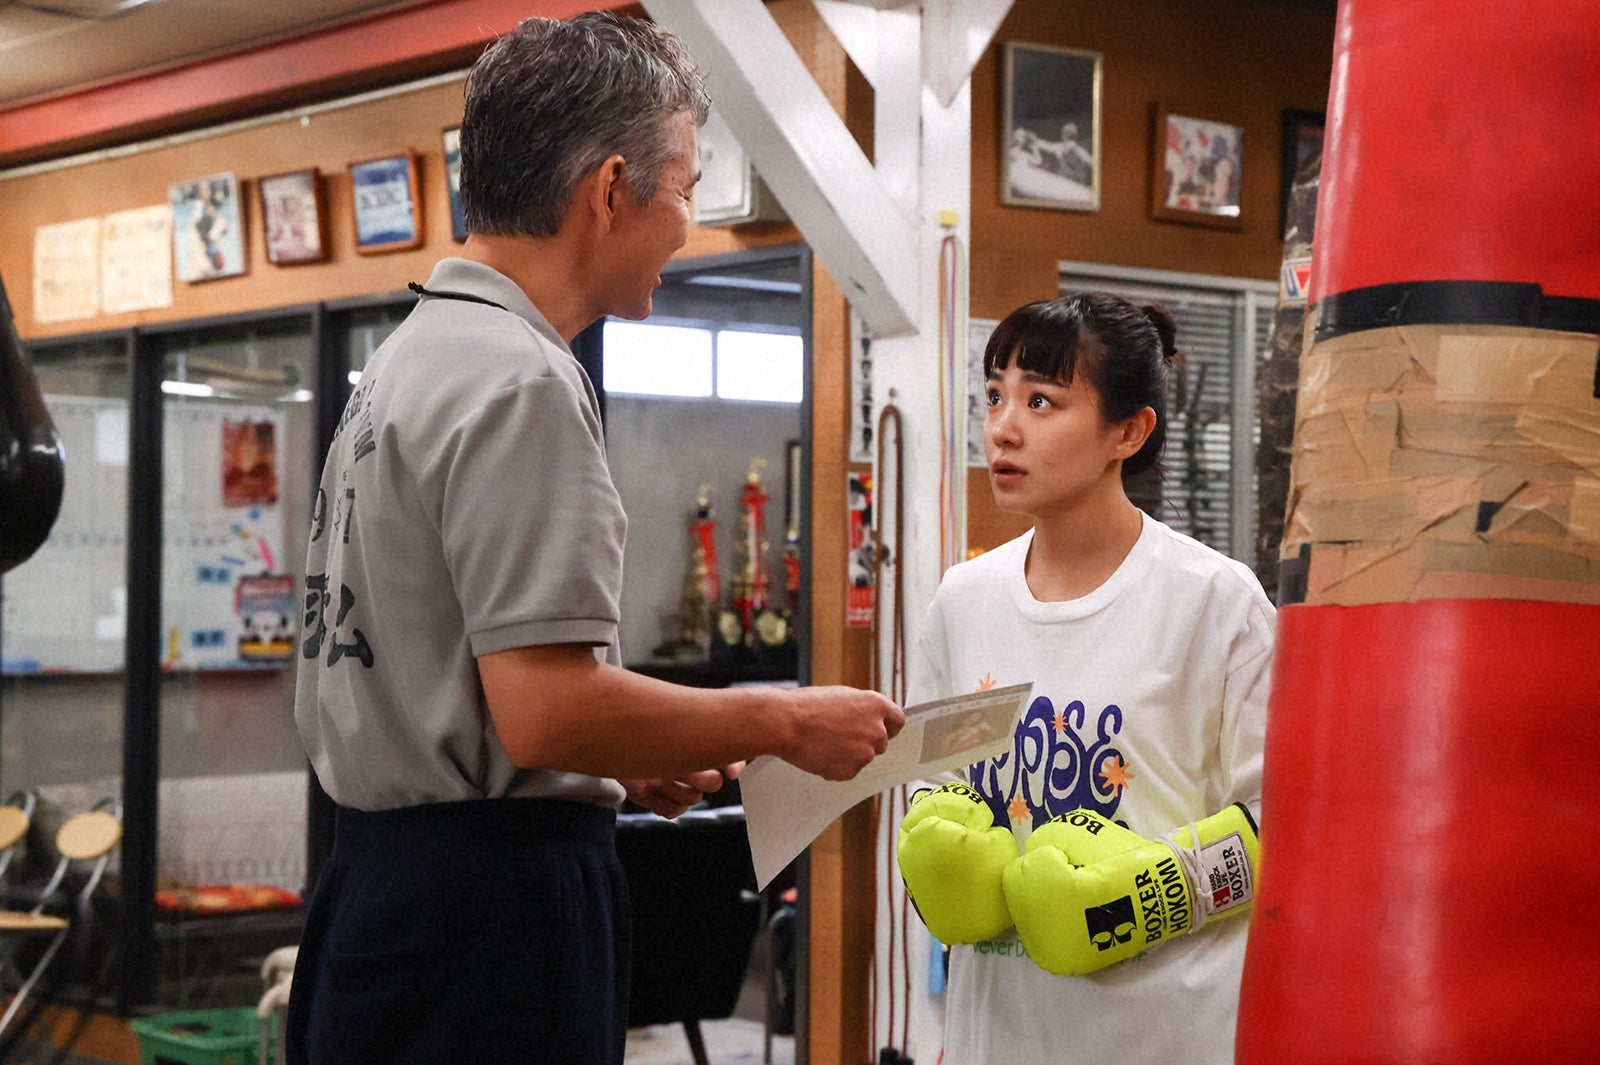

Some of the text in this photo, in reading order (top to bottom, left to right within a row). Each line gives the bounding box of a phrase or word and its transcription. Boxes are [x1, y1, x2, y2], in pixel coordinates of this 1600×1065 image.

[935, 785, 983, 805] BOX
[1052, 814, 1105, 836] BOX
[1212, 865, 1223, 889] KNOCK
[1221, 872, 1229, 887] LIFE
[1222, 845, 1244, 901] BOXER
[1135, 868, 1162, 944] BOXER
[1155, 856, 1188, 934] HOKOMI
